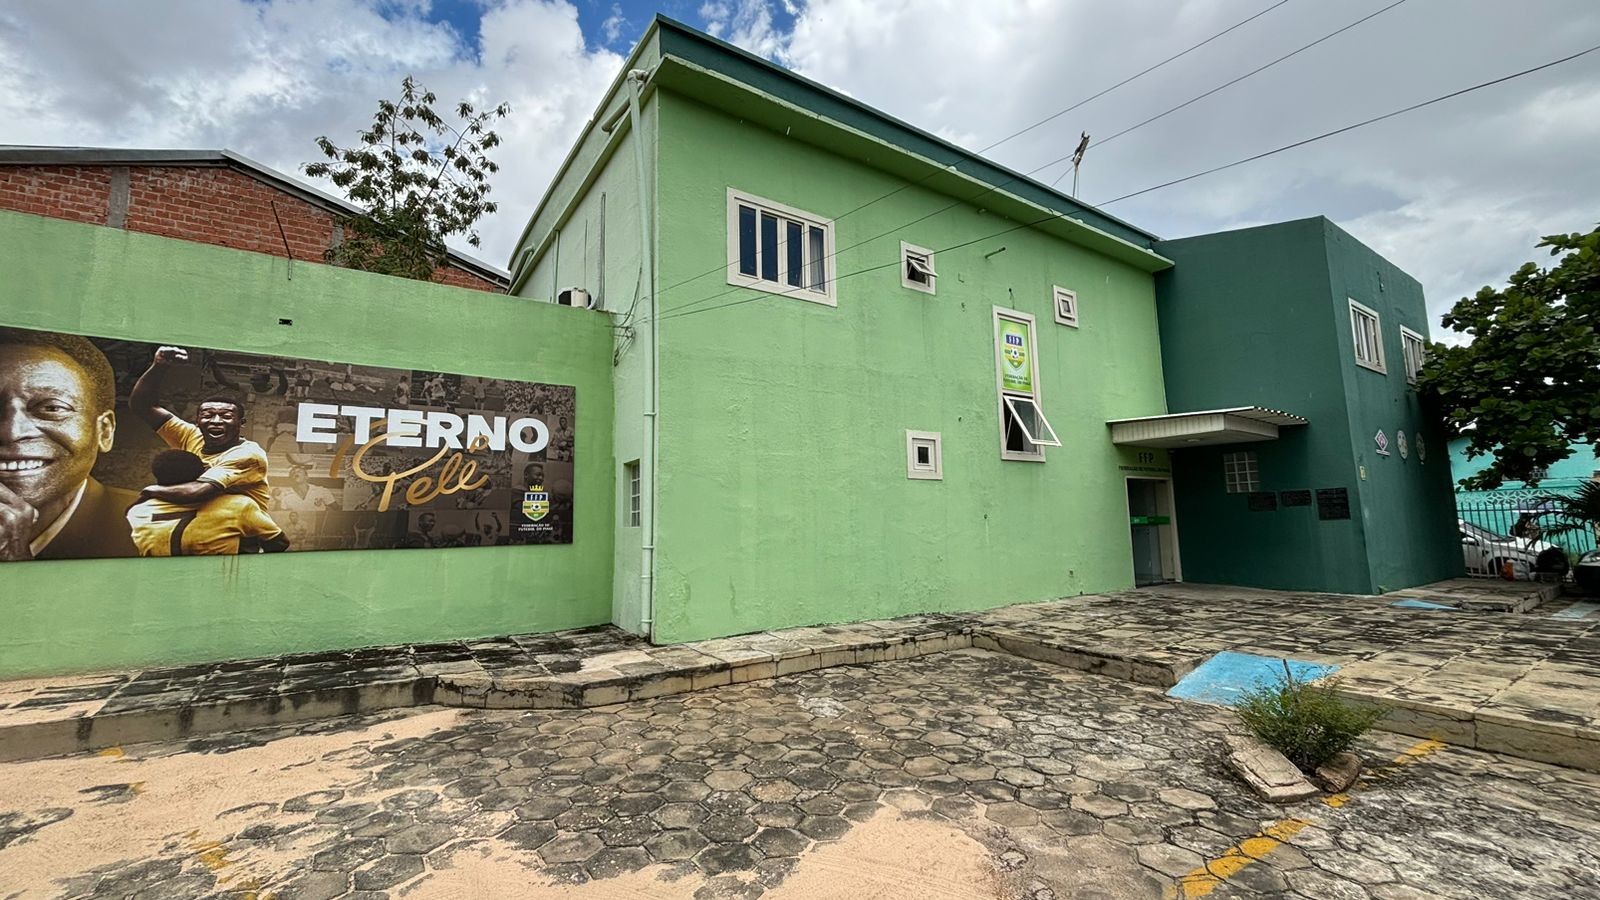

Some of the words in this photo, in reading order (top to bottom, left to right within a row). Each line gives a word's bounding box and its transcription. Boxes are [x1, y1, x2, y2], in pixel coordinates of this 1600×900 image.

[296, 402, 549, 454] ETERNO
[329, 418, 490, 513] Pelé
[1138, 452, 1154, 464] FFP
